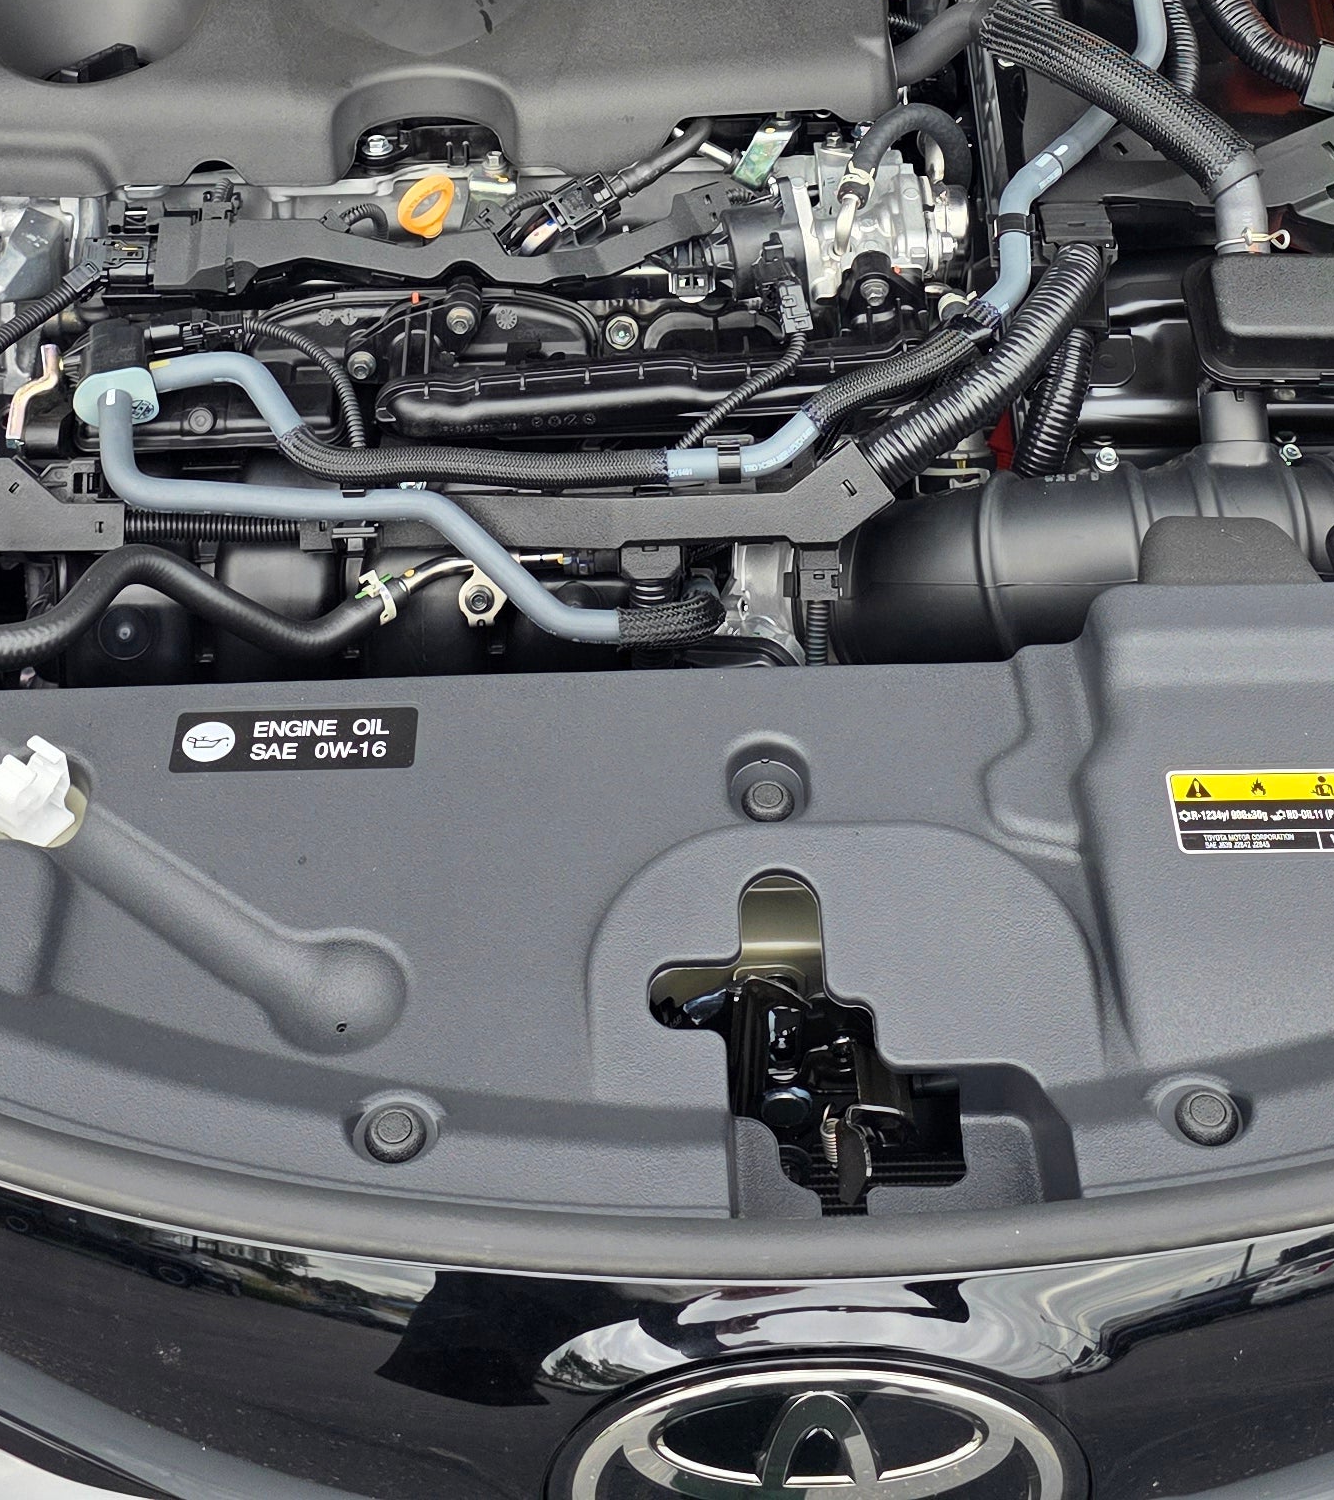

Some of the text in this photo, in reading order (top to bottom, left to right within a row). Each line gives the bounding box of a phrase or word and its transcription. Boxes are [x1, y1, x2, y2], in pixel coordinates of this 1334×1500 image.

[253, 718, 390, 738] ENGINE OIL
[250, 741, 387, 761] SAE 0W-16
[1251, 833, 1294, 841] CORPORATION
